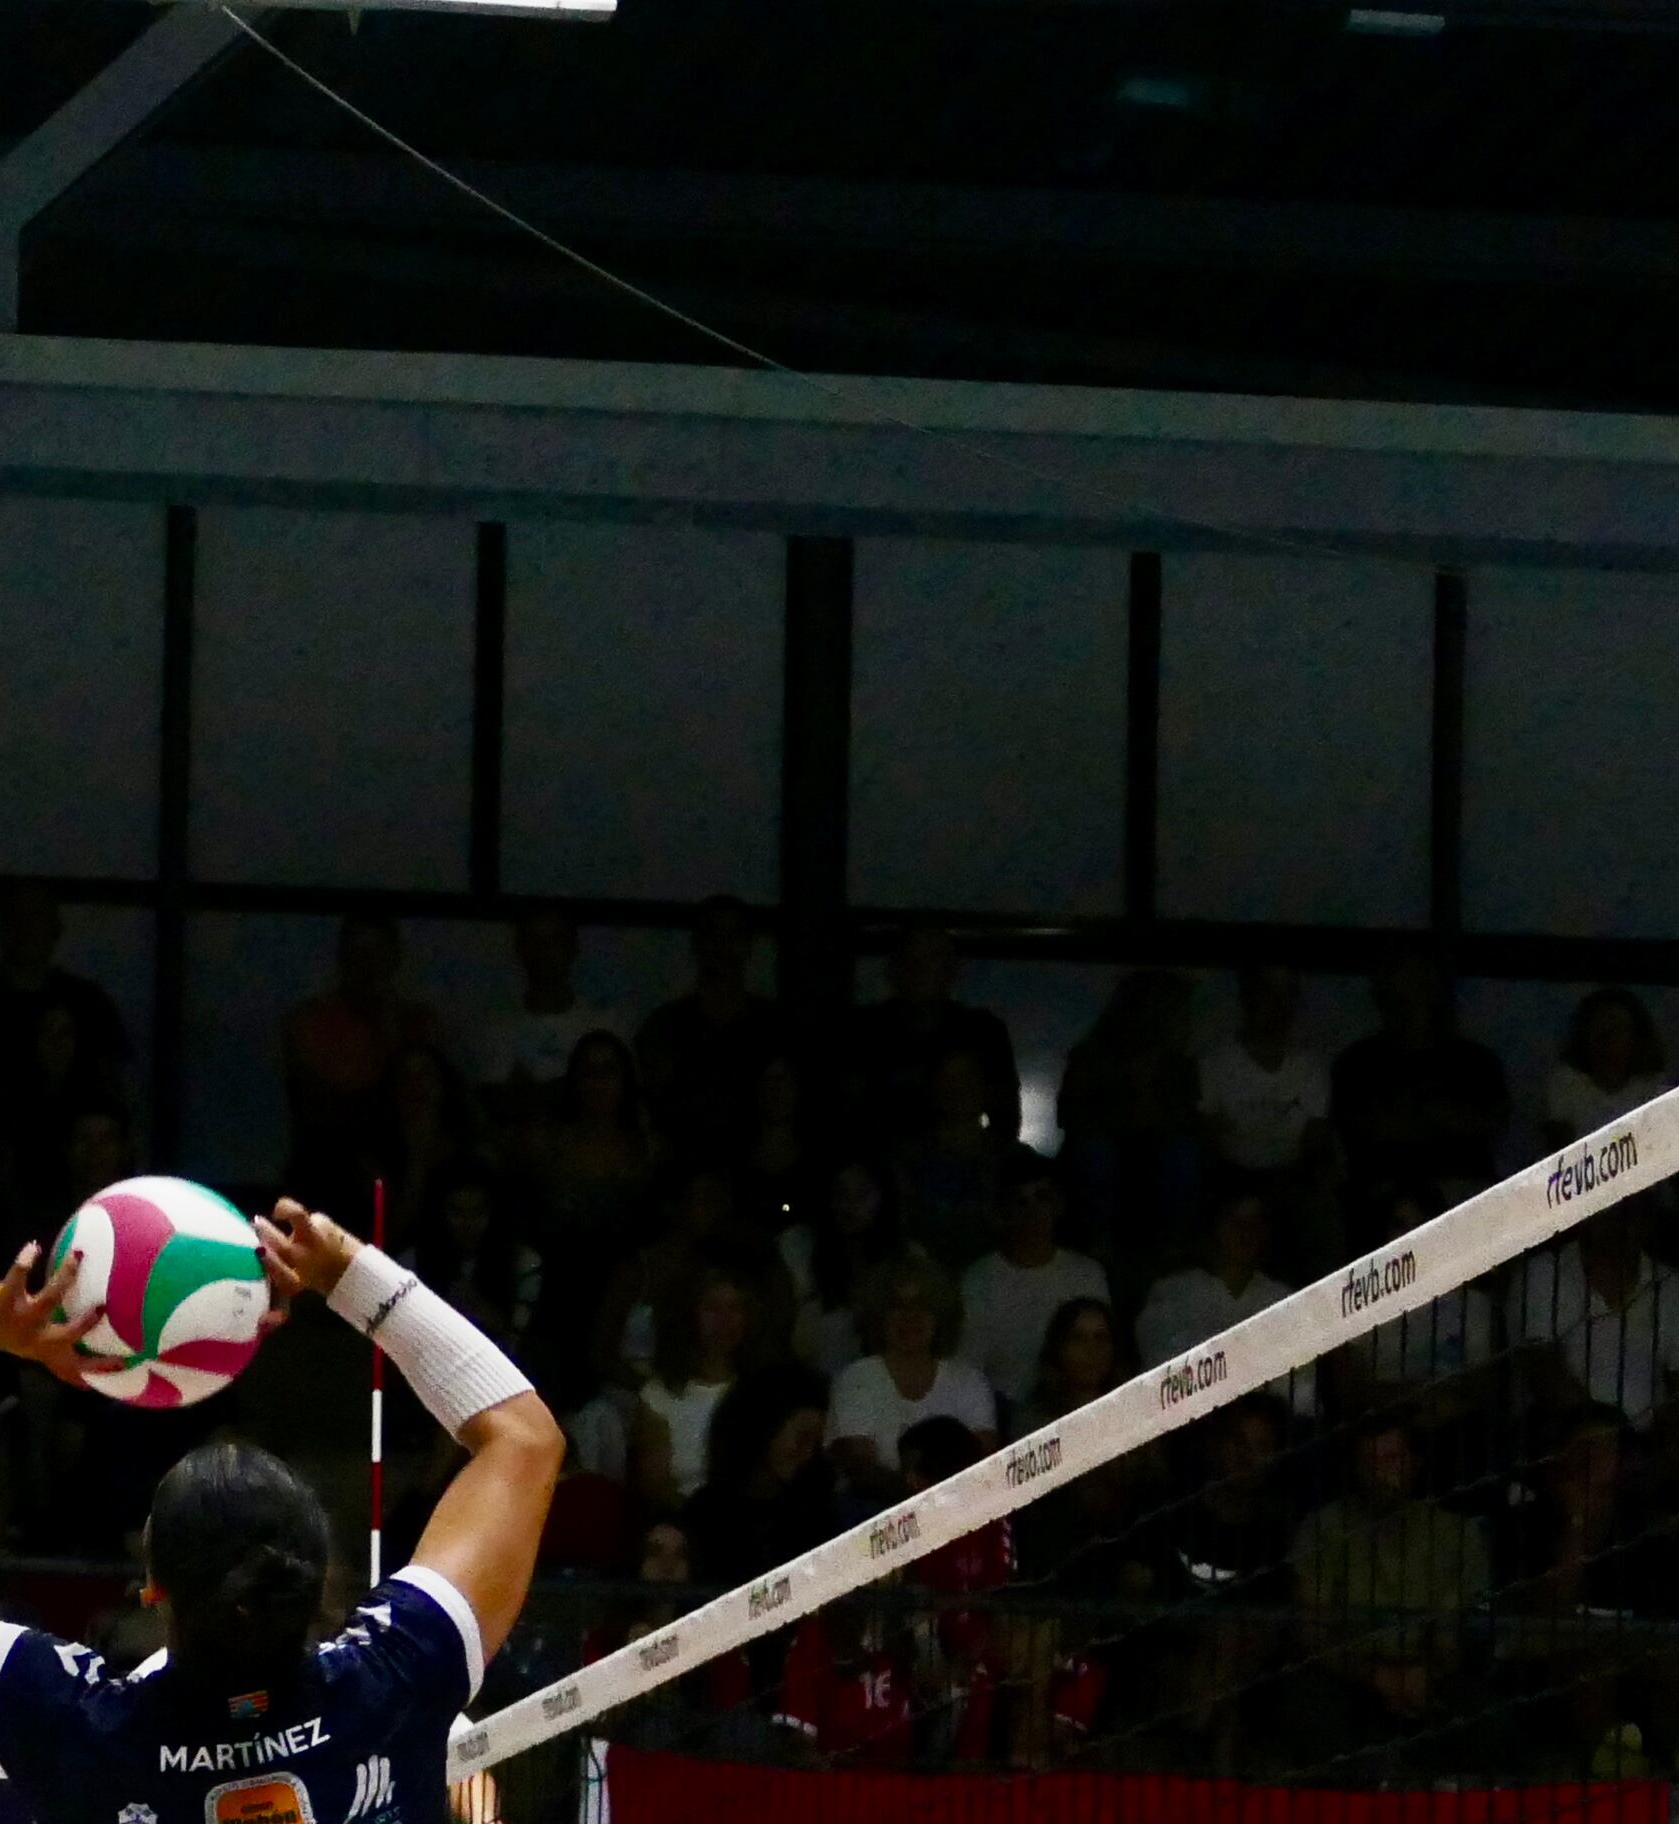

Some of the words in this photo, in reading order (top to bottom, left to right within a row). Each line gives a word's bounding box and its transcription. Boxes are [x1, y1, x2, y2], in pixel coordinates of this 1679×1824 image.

[1546, 1131, 1638, 1209] rfevb.com
[1340, 1248, 1417, 1318] rfevb.com
[1159, 1348, 1228, 1410] rfevb.com
[159, 1716, 331, 1773] MARTÍNEZ
